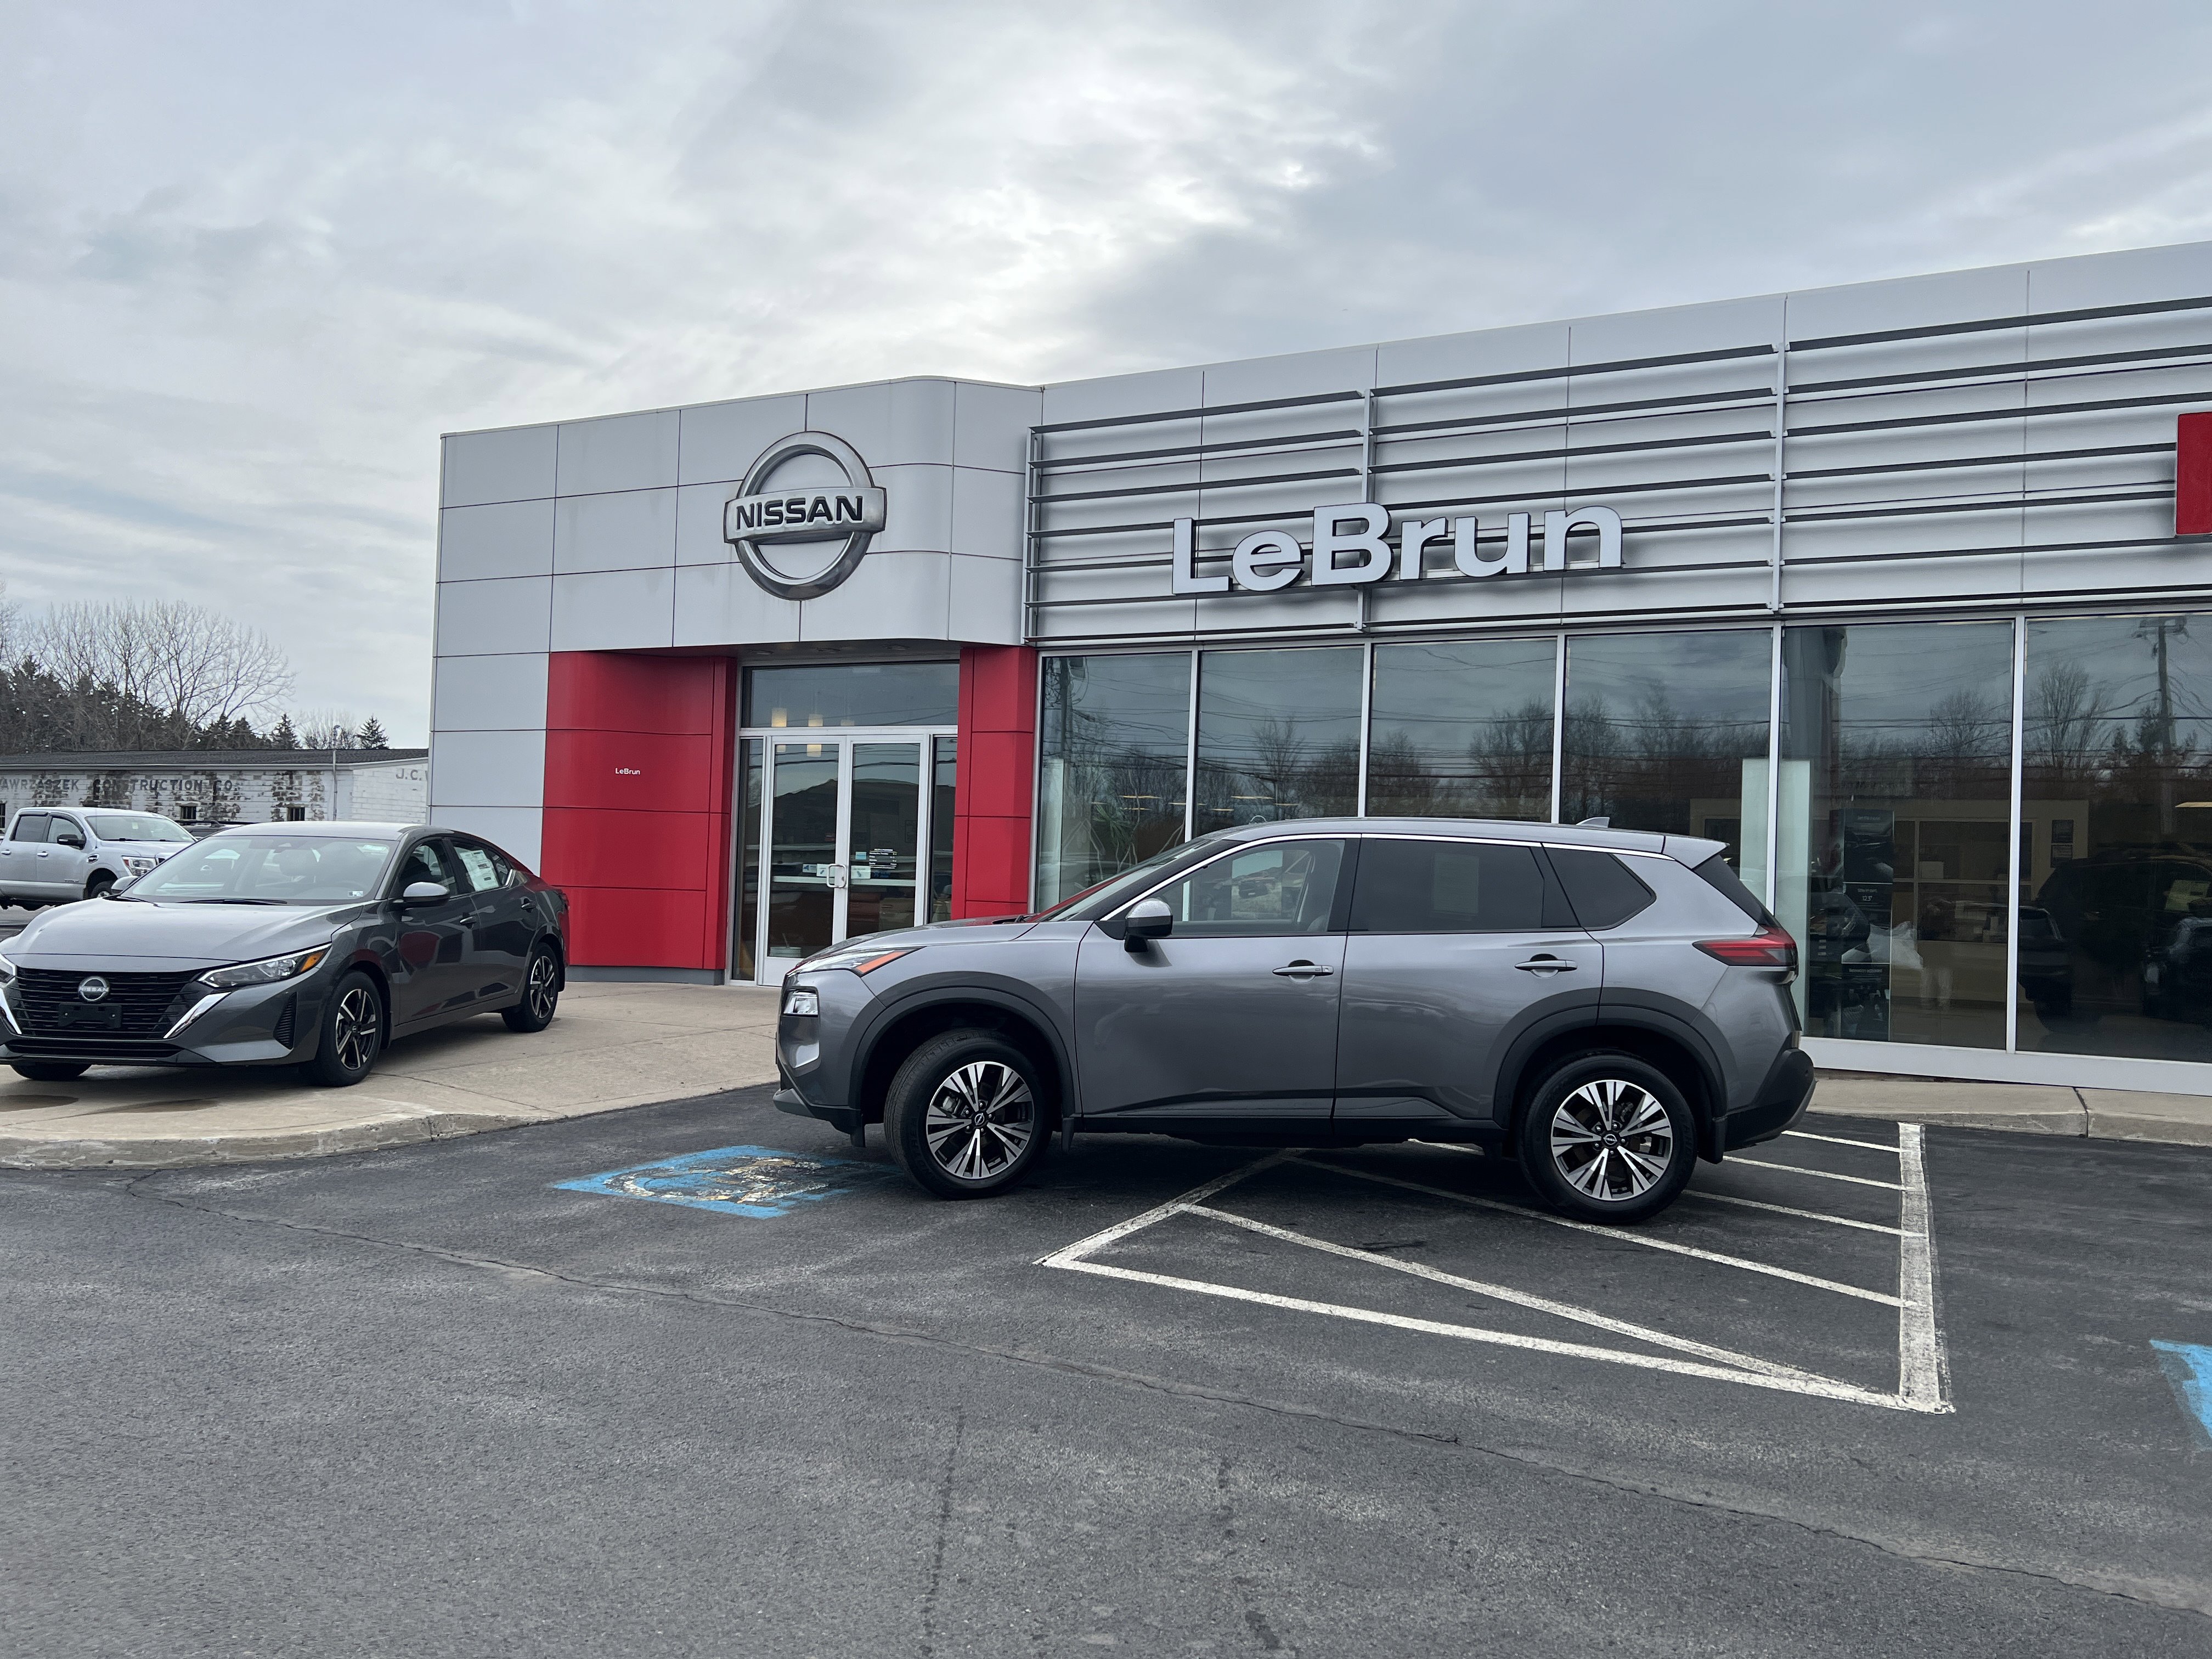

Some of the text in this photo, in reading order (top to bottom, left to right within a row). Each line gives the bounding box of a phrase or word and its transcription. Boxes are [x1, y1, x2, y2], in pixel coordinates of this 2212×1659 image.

[736, 495, 864, 531] NISSAN
[1171, 501, 1625, 595] LeBrun
[93, 779, 203, 792] CONTRUCTION
[396, 768, 421, 781] J.C.
